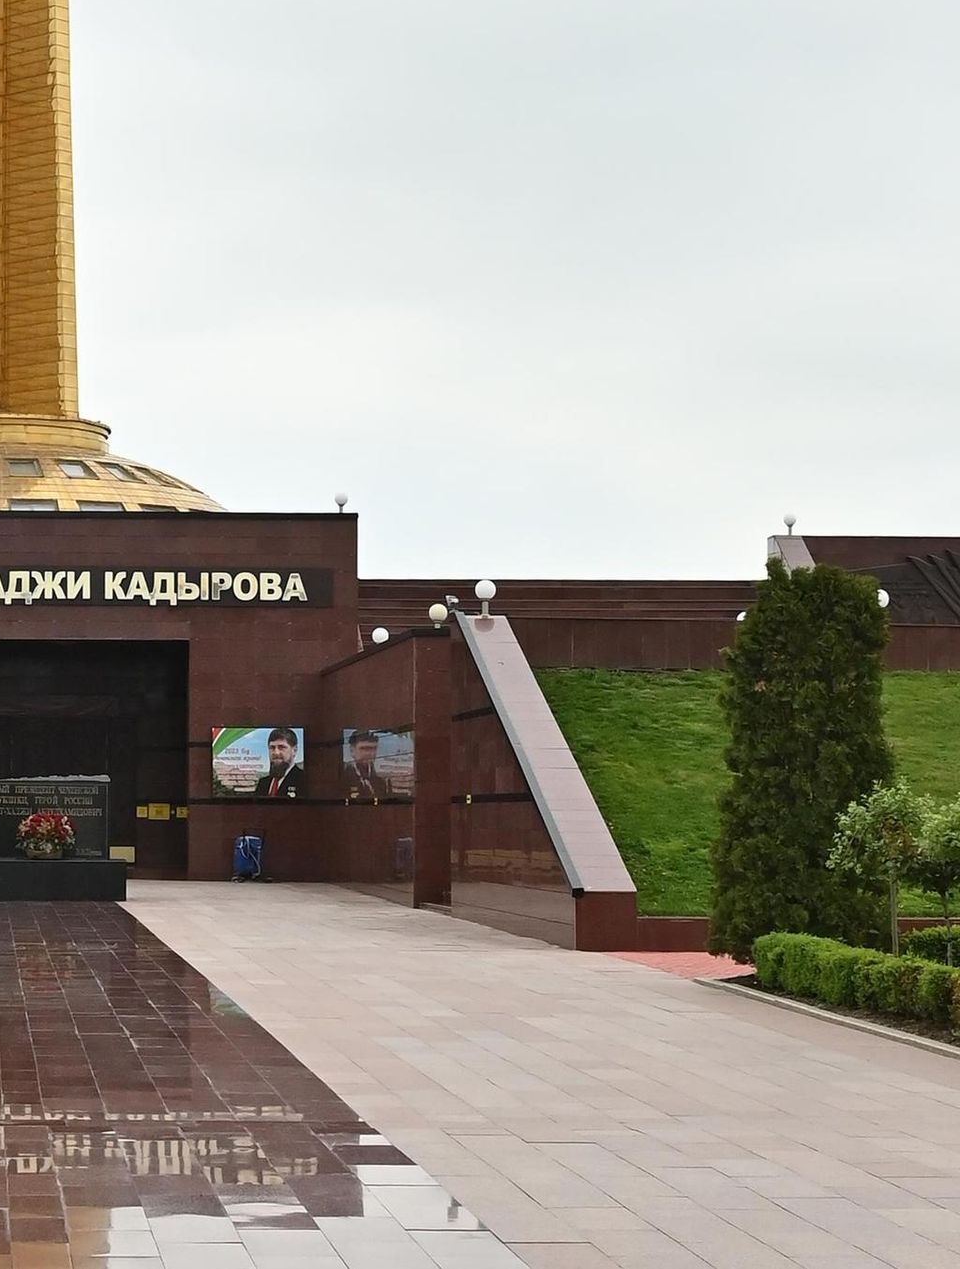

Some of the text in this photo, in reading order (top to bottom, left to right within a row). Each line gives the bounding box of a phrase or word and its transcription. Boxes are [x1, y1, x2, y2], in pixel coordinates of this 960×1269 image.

[104, 571, 308, 606] КАДЫРОВА
[15, 785, 56, 795] ПРЕЗИДЕНТ
[34, 795, 58, 805] ГЕРОЙ
